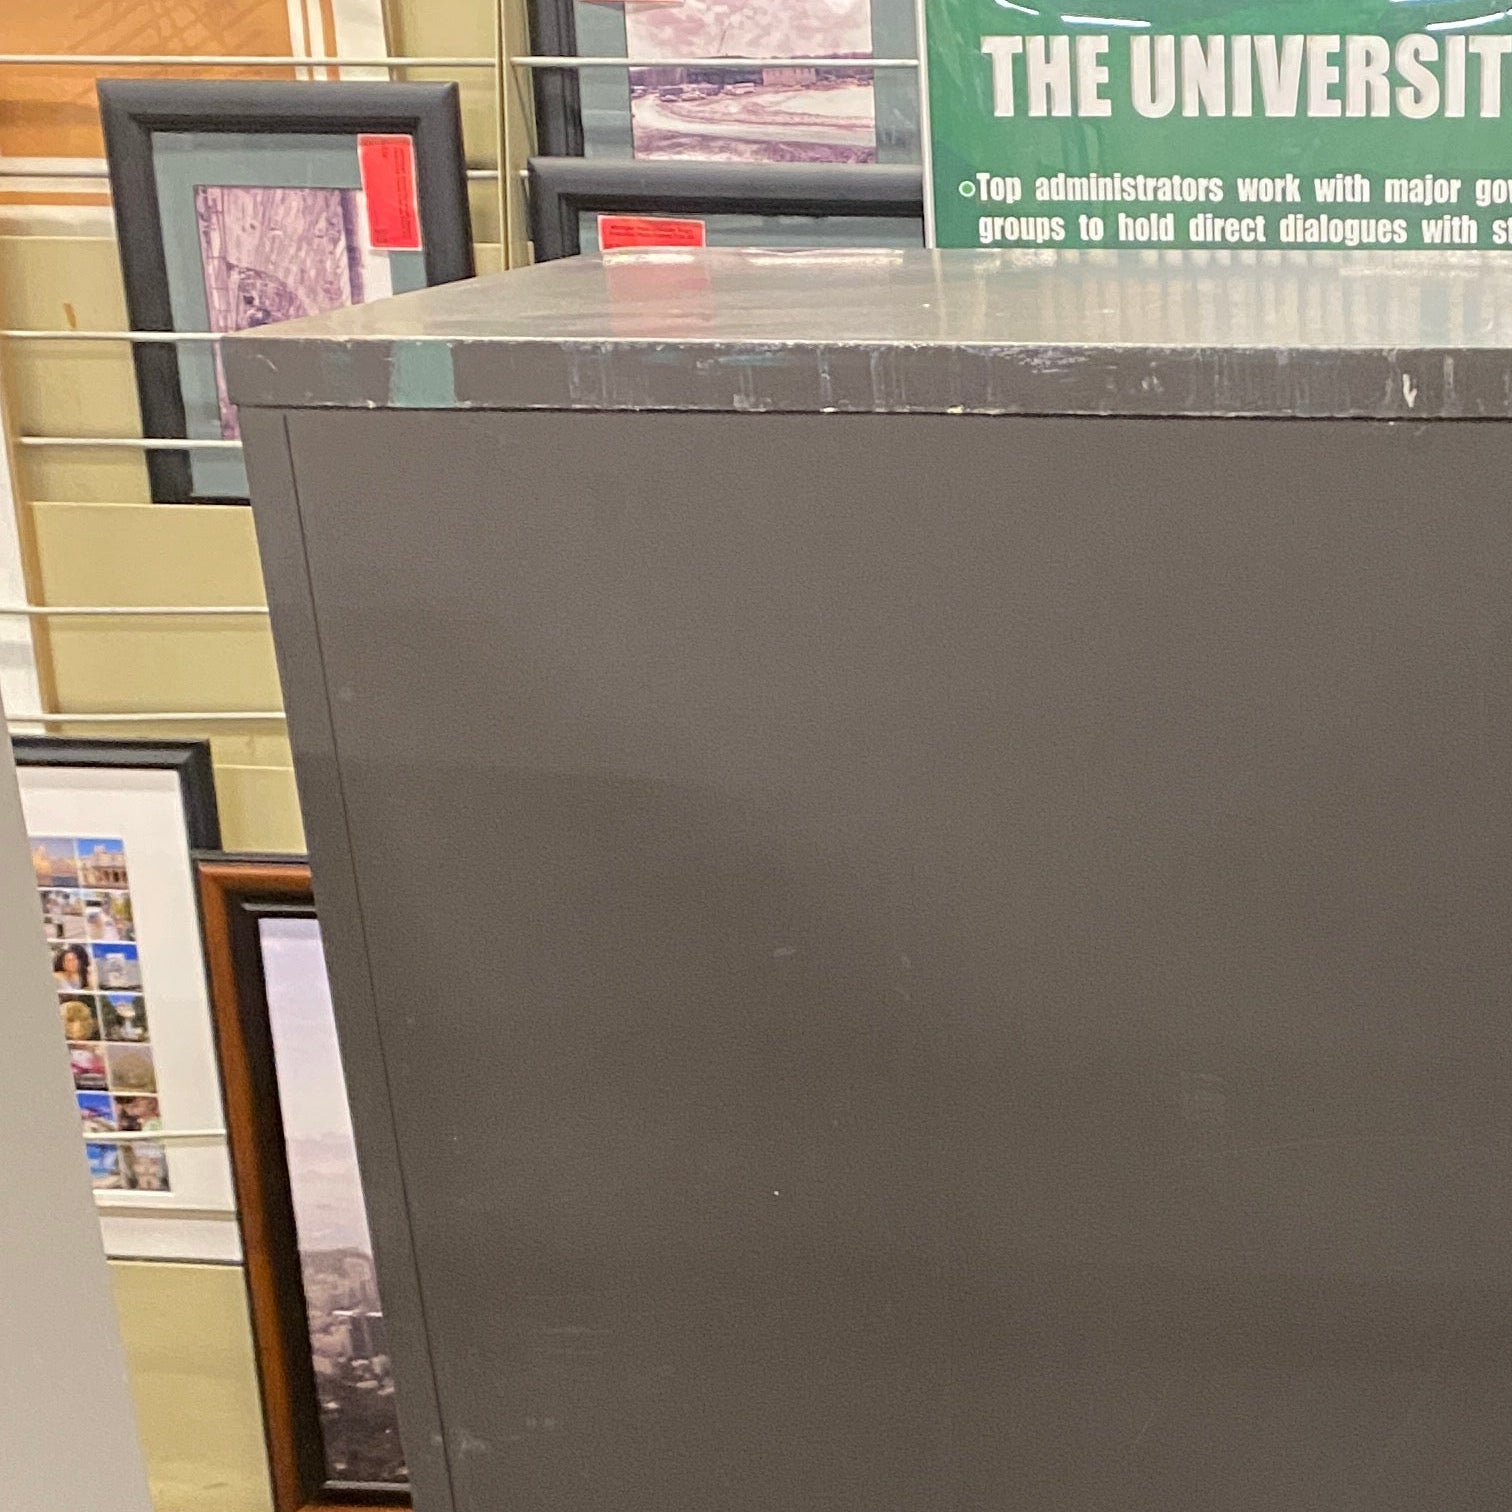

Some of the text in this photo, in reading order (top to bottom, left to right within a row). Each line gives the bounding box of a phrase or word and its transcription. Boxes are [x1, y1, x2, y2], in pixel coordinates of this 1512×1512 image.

[980, 35, 1112, 117] THE
[976, 172, 1021, 203] Top
[1035, 173, 1223, 202] administrators
[1237, 173, 1301, 202] work
[1314, 173, 1370, 202] with
[1385, 174, 1461, 206] major
[978, 216, 1065, 243] groups
[1079, 214, 1104, 241] to
[1118, 212, 1174, 242] hold
[1189, 213, 1266, 242] direct
[1279, 213, 1407, 246] dialogues
[1421, 214, 1478, 243] with
